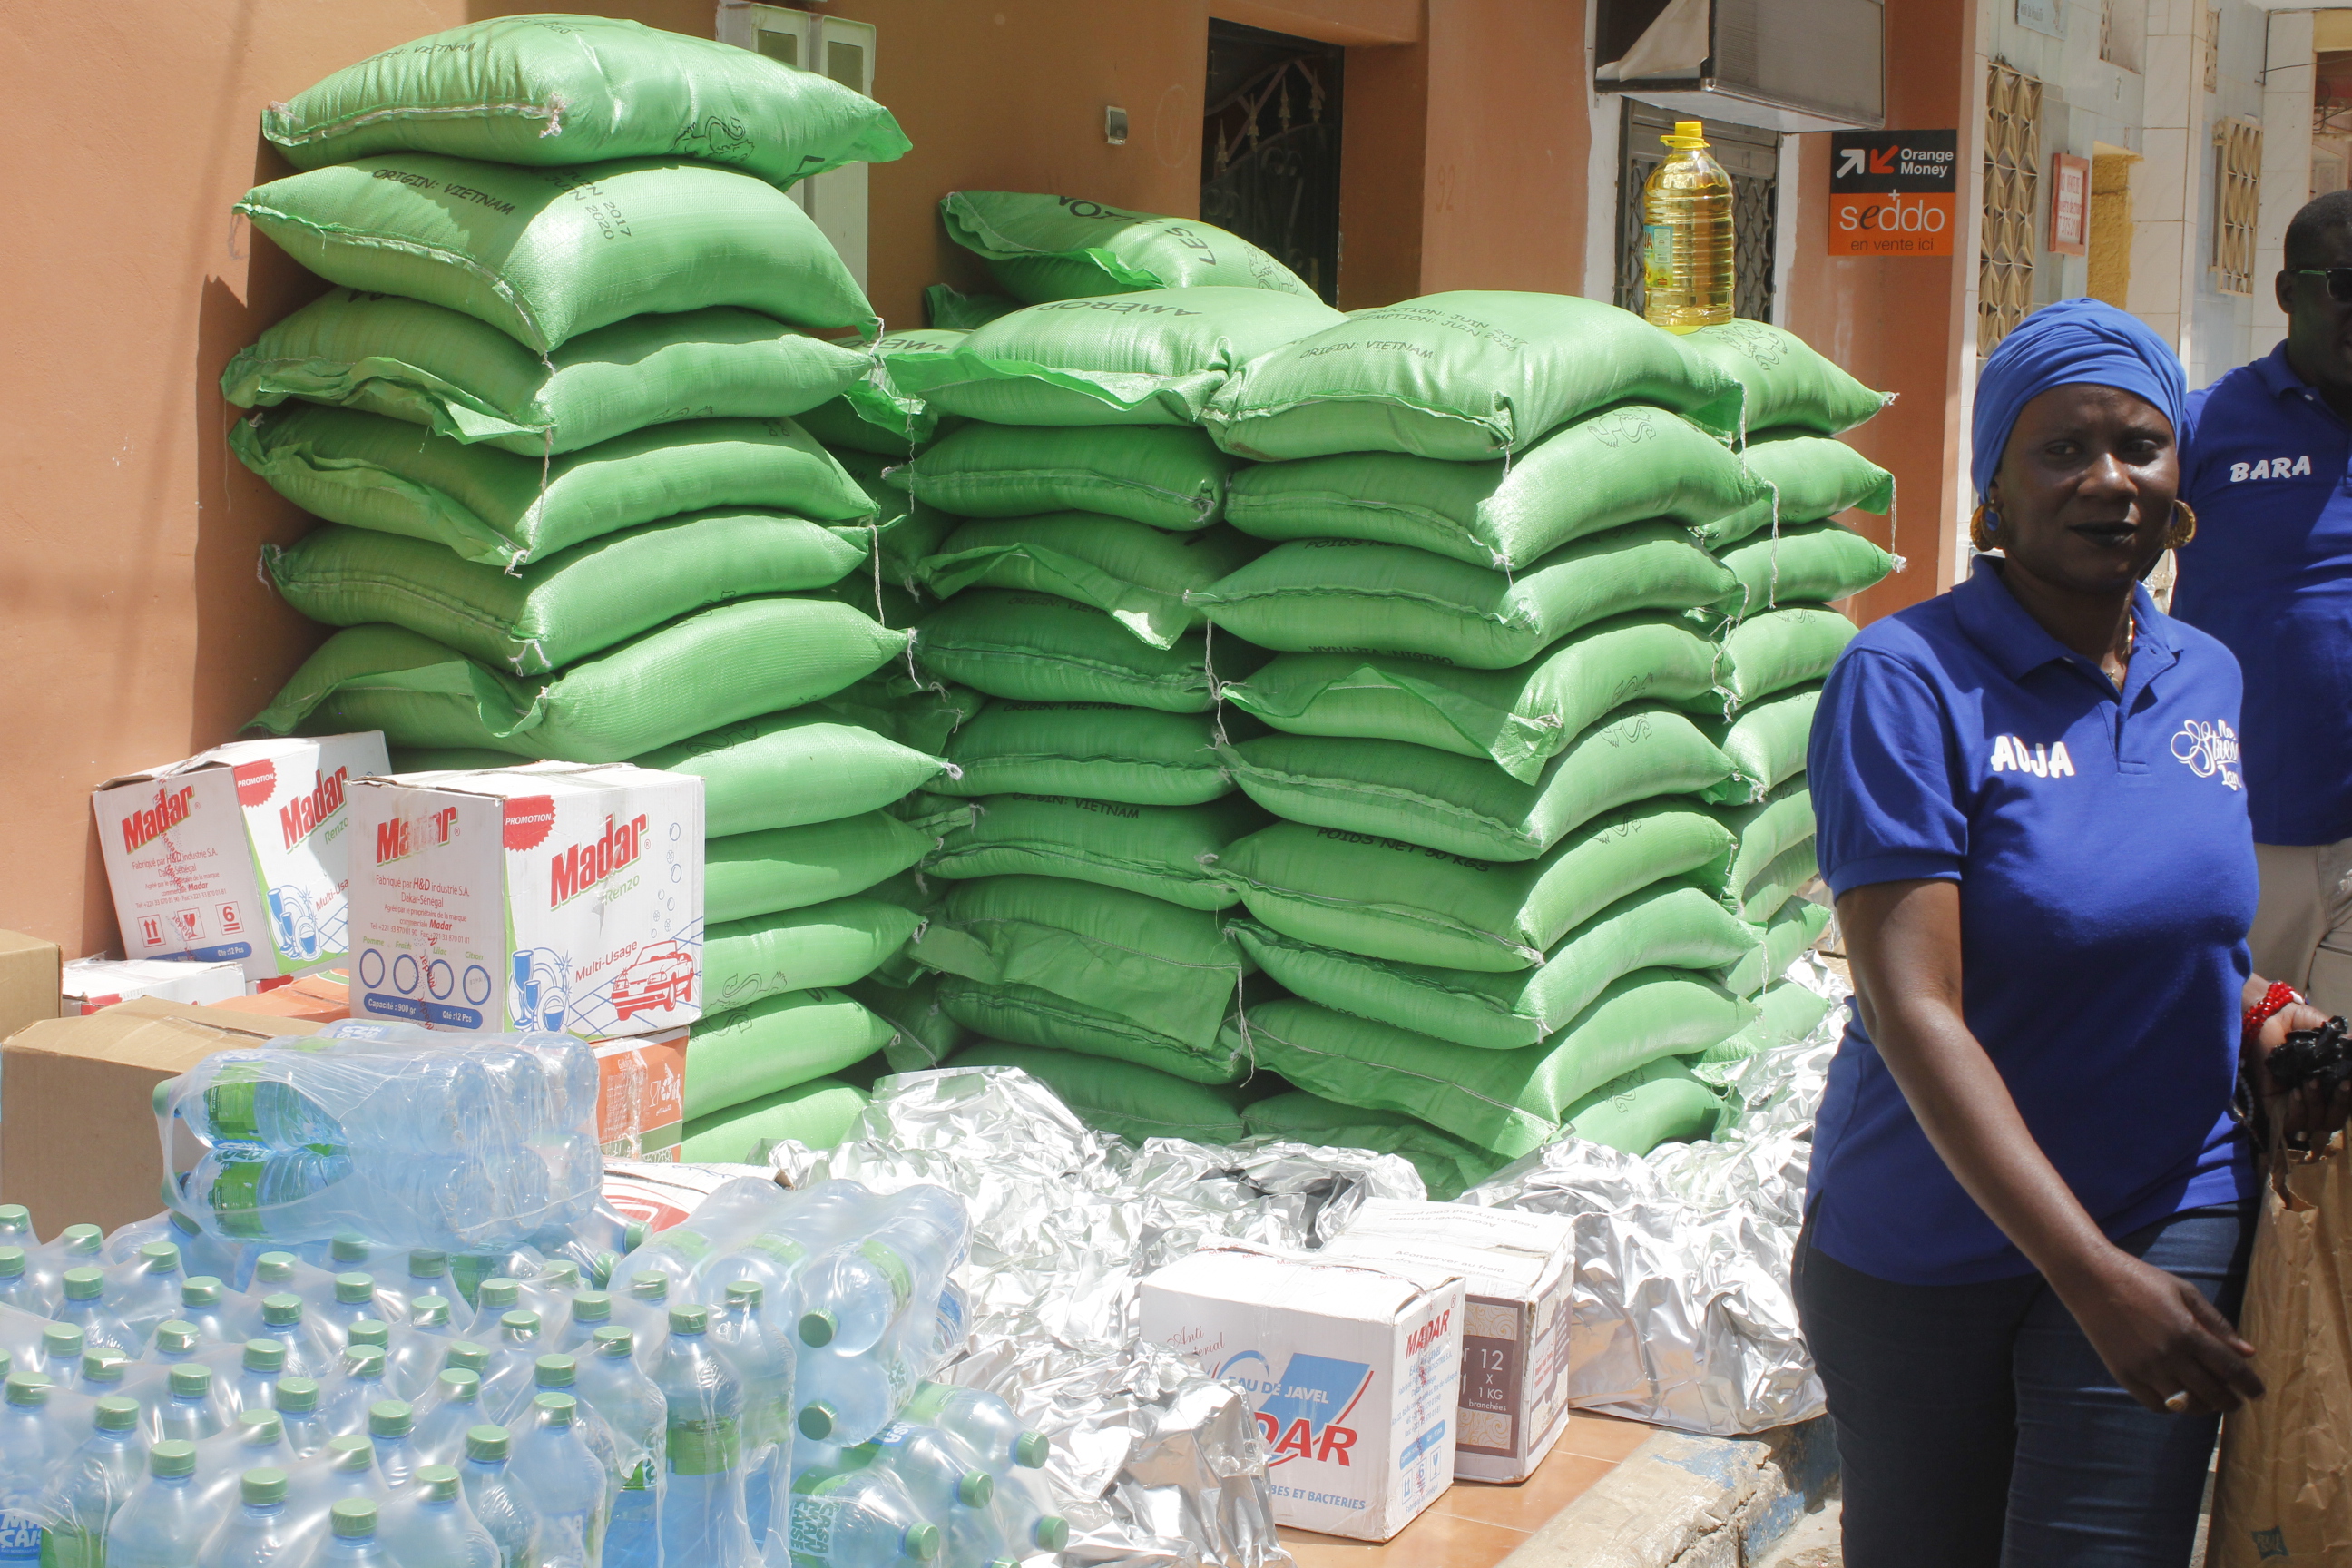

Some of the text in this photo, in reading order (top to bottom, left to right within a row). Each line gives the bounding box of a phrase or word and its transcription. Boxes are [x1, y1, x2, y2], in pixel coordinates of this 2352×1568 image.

[414, 42, 476, 54] VIETNAM
[1901, 148, 1953, 163] Orange
[1901, 162, 1948, 178] Money
[372, 168, 516, 215] ORIGIN: VIETNAM
[545, 175, 614, 240] JUIN 2020
[562, 171, 631, 238] JUIN 2017
[1840, 199, 1945, 232] seddo
[1164, 227, 1217, 265] LES
[1851, 238, 1933, 250] en vente ici
[1441, 319, 1517, 352] JUIN 2020
[1450, 313, 1490, 328] JUIN
[1494, 329, 1529, 345] 2017
[1299, 341, 1434, 359] ORIGIN: VIETNAM
[2230, 456, 2311, 483] BARA
[237, 773, 274, 788] PROMOTION
[122, 784, 193, 854] Madar
[279, 766, 348, 850] Madar
[505, 813, 551, 825] PROMOTION
[1075, 798, 1139, 818] VIETNAM
[132, 858, 156, 870] Fabriqué
[157, 858, 166, 867] par
[183, 850, 206, 861] industrie
[207, 848, 218, 858] S.A.
[551, 813, 647, 908] Madar
[1317, 828, 1372, 844] POIDS
[1380, 838, 1417, 853] NET
[1453, 855, 1490, 872] KGS
[188, 882, 208, 891] Madar
[316, 878, 348, 910] Multi-Usa
[376, 875, 469, 897] Fabriqué par H&D industrie S.A.
[605, 875, 639, 905] Renzo
[401, 892, 443, 909] Dakar-Sénégal
[223, 906, 235, 921] 6
[411, 909, 436, 919] propriétaire
[449, 914, 467, 923] marque
[429, 919, 452, 931] Madar
[363, 936, 384, 946] Pomme
[433, 947, 447, 956] Lilac
[465, 951, 483, 960] Citron
[575, 941, 637, 983] Multi-Usage
[368, 999, 393, 1010] Capacité
[398, 1003, 409, 1013] 900
[442, 1010, 451, 1019] Qté
[462, 1014, 472, 1022] Pcs
[1434, 1217, 1496, 1228] Aconserver
[1511, 1220, 1539, 1229] Keep
[1395, 1250, 1458, 1264] Aconserver
[1479, 1264, 1505, 1274] froid
[1168, 1326, 1204, 1346] Anti
[1194, 1332, 1225, 1357] terial
[1406, 1309, 1450, 1360] MADAR
[1481, 1349, 1503, 1371] 12
[1261, 1382, 1281, 1396] DE
[1285, 1386, 1329, 1404] JAVEL
[1479, 1387, 1503, 1400] 1 KG
[1469, 1398, 1506, 1411] branchées
[1254, 1412, 1357, 1467] DAR
[1418, 1463, 1424, 1479] 6
[1271, 1485, 1366, 1510] BES ET BACTERIES
